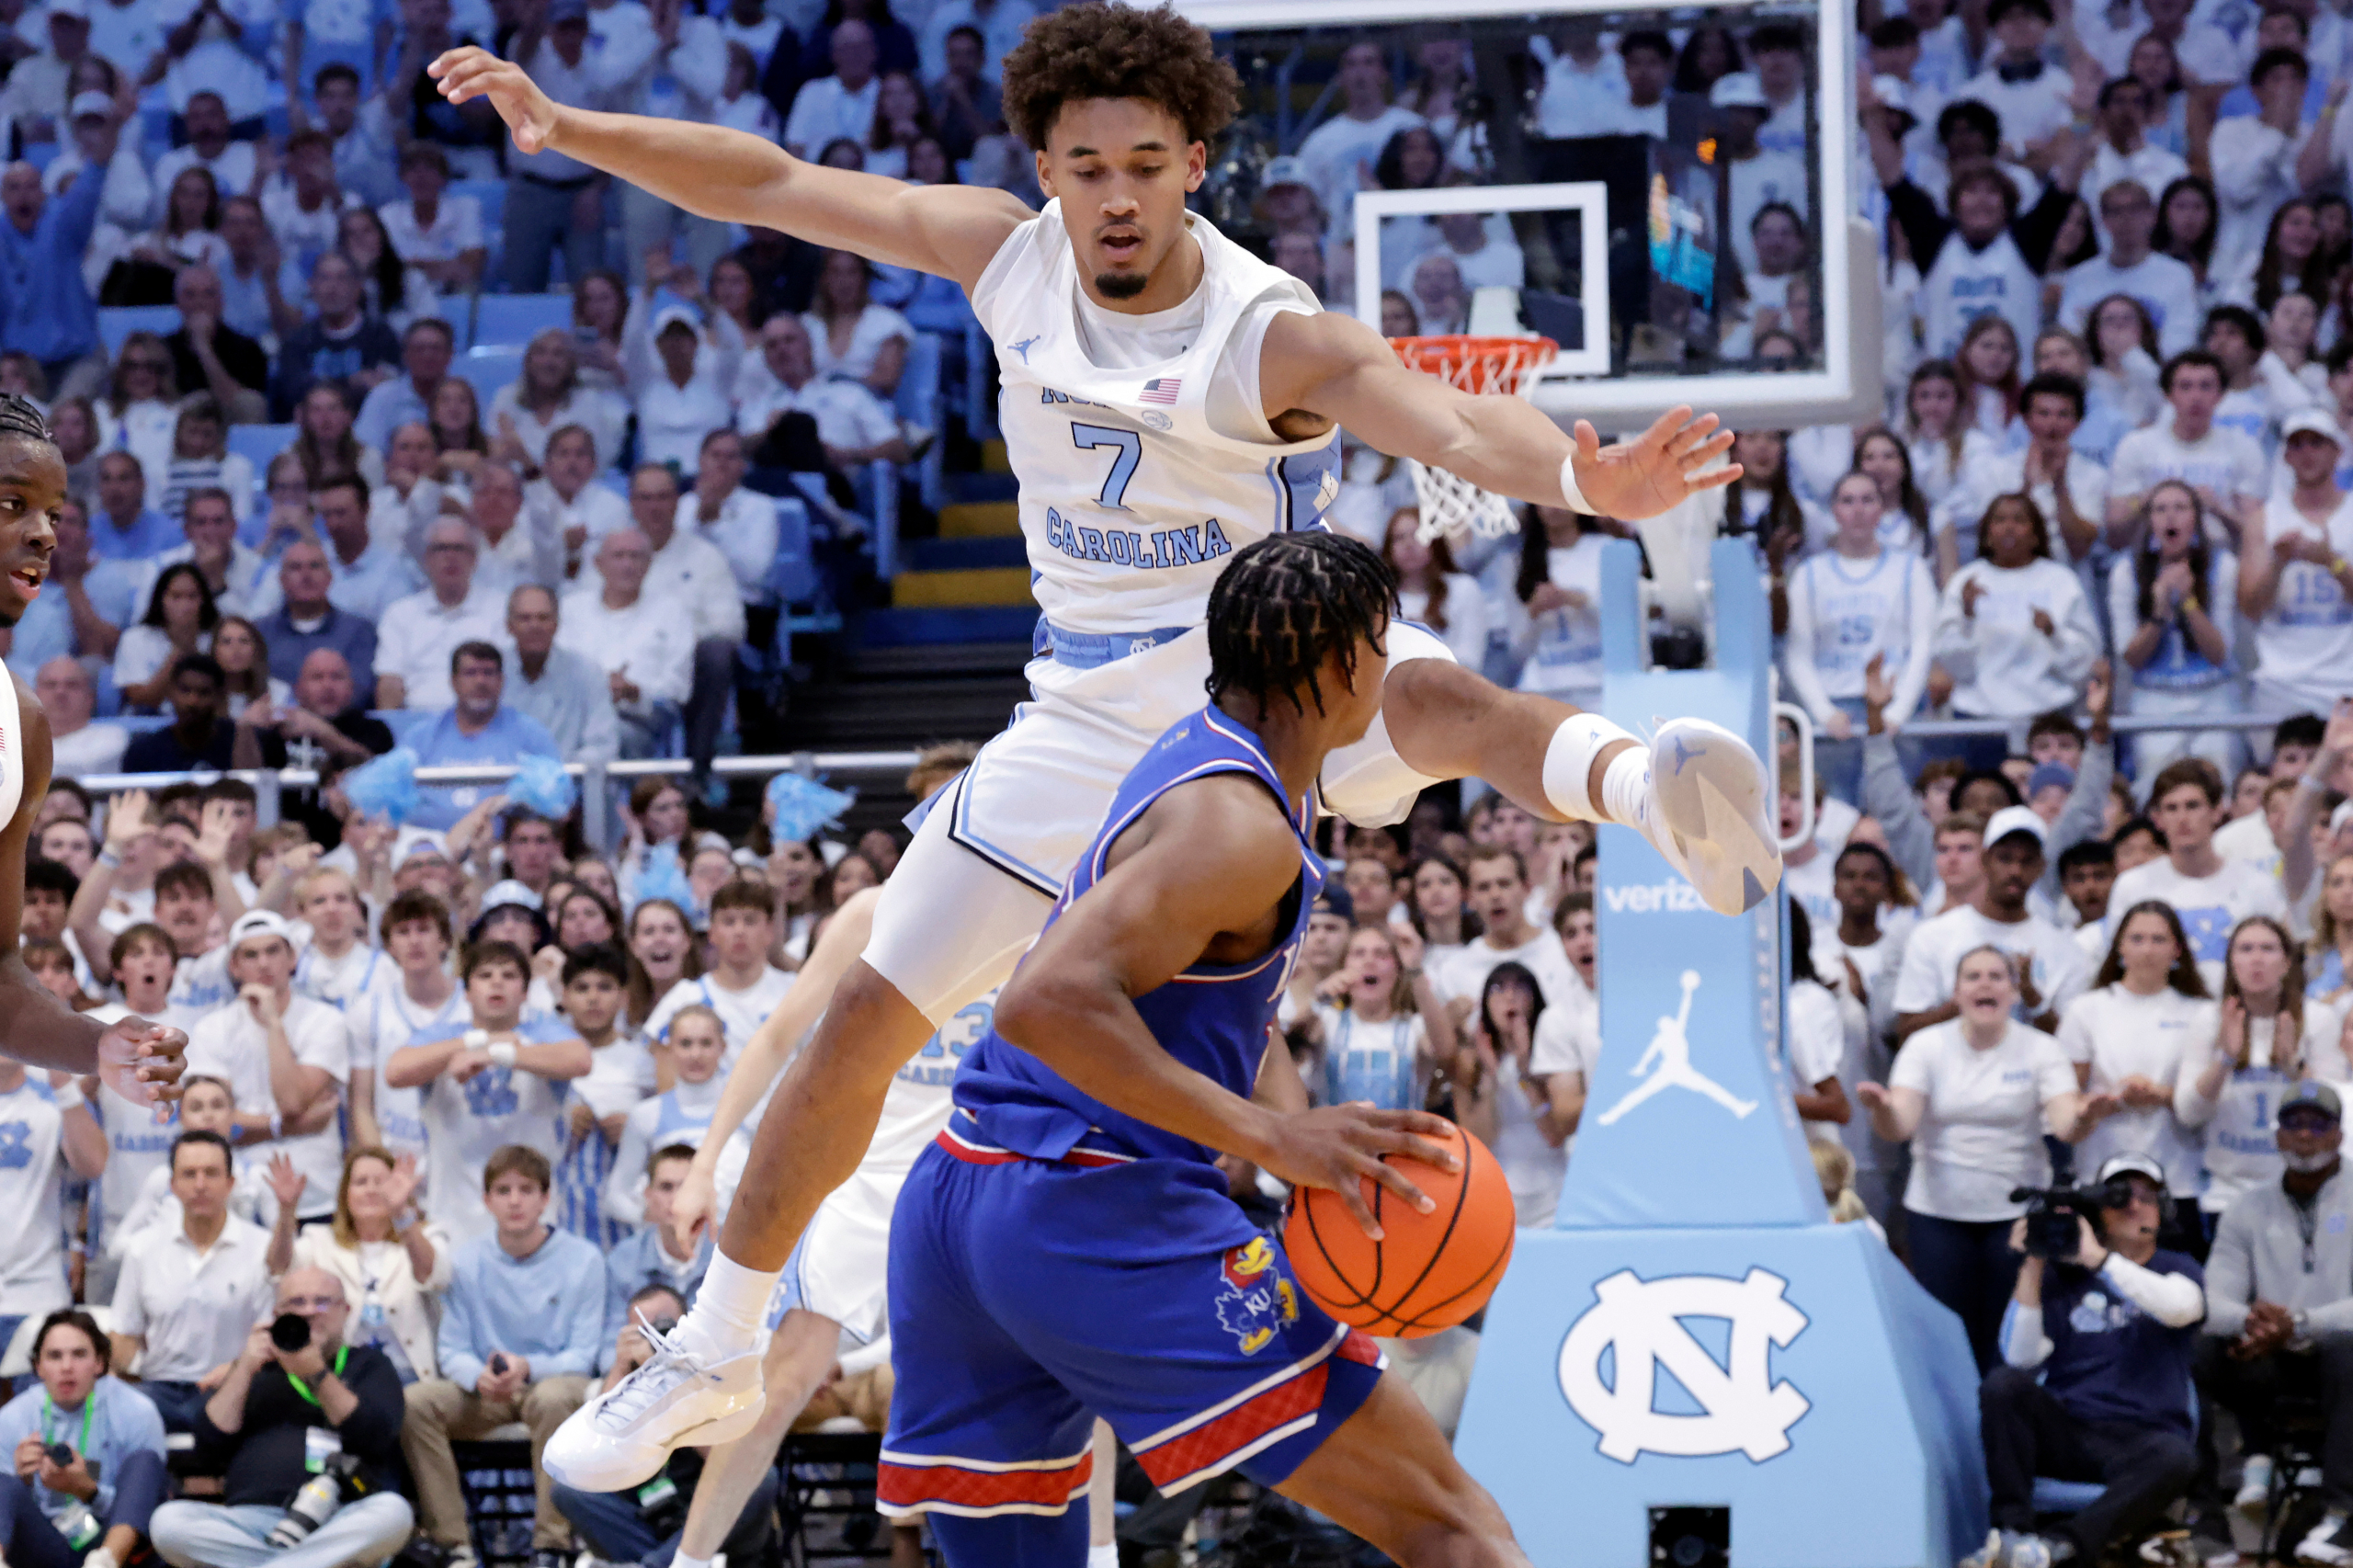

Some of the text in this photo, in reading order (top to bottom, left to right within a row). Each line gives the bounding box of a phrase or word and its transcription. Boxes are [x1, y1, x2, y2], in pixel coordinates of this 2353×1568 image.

[1071, 421, 1142, 513] 7
[1047, 506, 1233, 569] CAROLINA
[1245, 1287, 1272, 1316] KU
